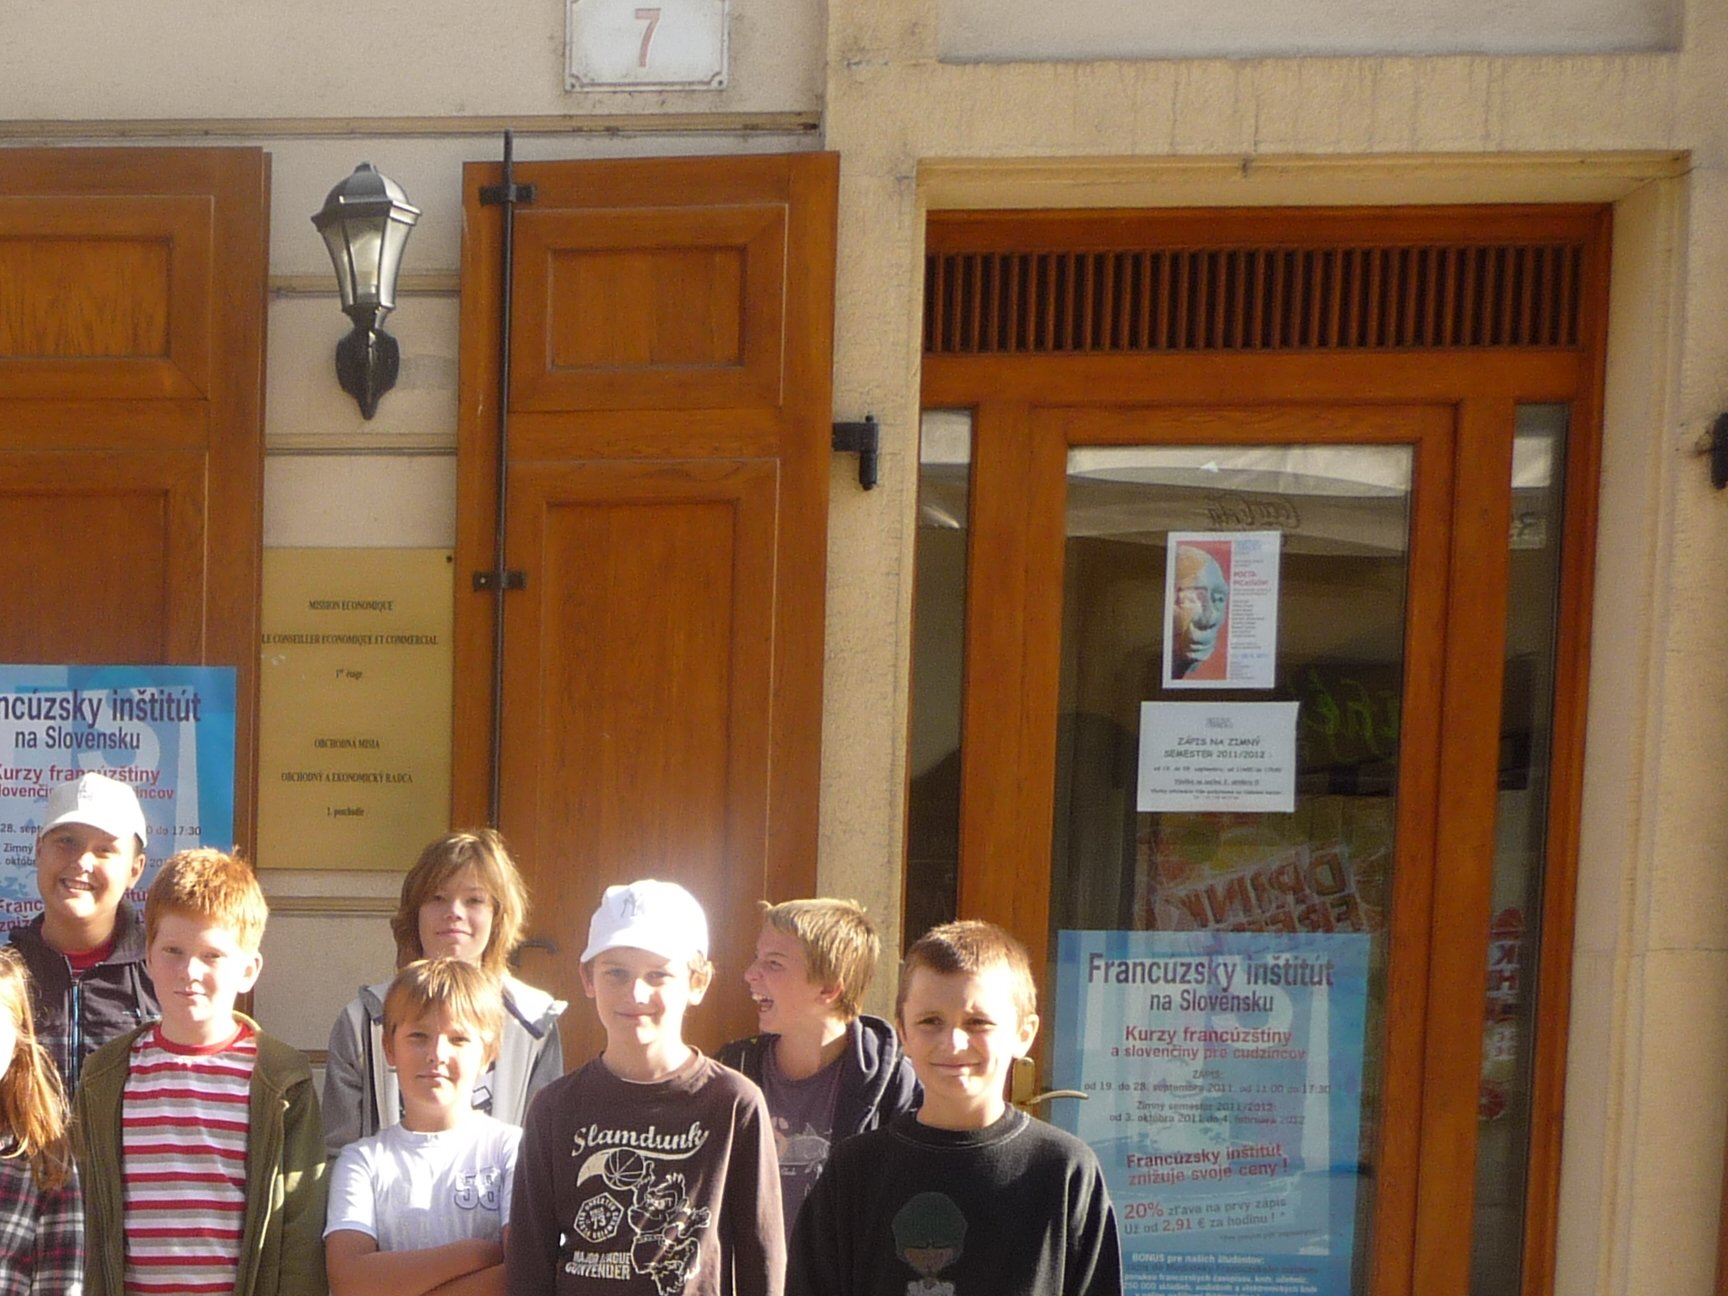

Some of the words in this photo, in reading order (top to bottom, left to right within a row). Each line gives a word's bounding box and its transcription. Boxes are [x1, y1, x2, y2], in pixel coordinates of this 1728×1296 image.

[634, 8, 661, 67] 7
[112, 689, 201, 724] inštitút
[14, 730, 37, 749] na
[45, 726, 140, 750] Slovensku
[0, 823, 16, 833] 28.
[172, 826, 202, 836] 17:30
[3, 843, 34, 854] Zimný
[1246, 953, 1334, 988] inštitút
[1149, 994, 1172, 1011] na
[1180, 989, 1274, 1013] Slovensku
[1125, 1026, 1176, 1045] Kurzy
[1183, 1026, 1292, 1046] francúzštiny
[1111, 1048, 1119, 1058] a
[1124, 1045, 1199, 1060] slovenčiny
[1204, 1048, 1227, 1060] pre
[1233, 1046, 1306, 1060] cudzincov
[1084, 1081, 1096, 1091] od
[1118, 1081, 1130, 1091] do
[1109, 1113, 1122, 1122] od
[572, 1120, 710, 1157] Slamdunk
[1128, 1167, 1185, 1187] znižuje
[1191, 1164, 1233, 1182] svoje
[1239, 1162, 1278, 1181] ceny
[1124, 1202, 1164, 1220] 20%
[1206, 1203, 1221, 1213] na
[1144, 1222, 1159, 1233] od
[1162, 1218, 1192, 1233] 2,91
[1197, 1218, 1206, 1229] €
[1210, 1218, 1223, 1228] za
[1227, 1213, 1268, 1226] hodinu
[1132, 1252, 1164, 1263] BONUS
